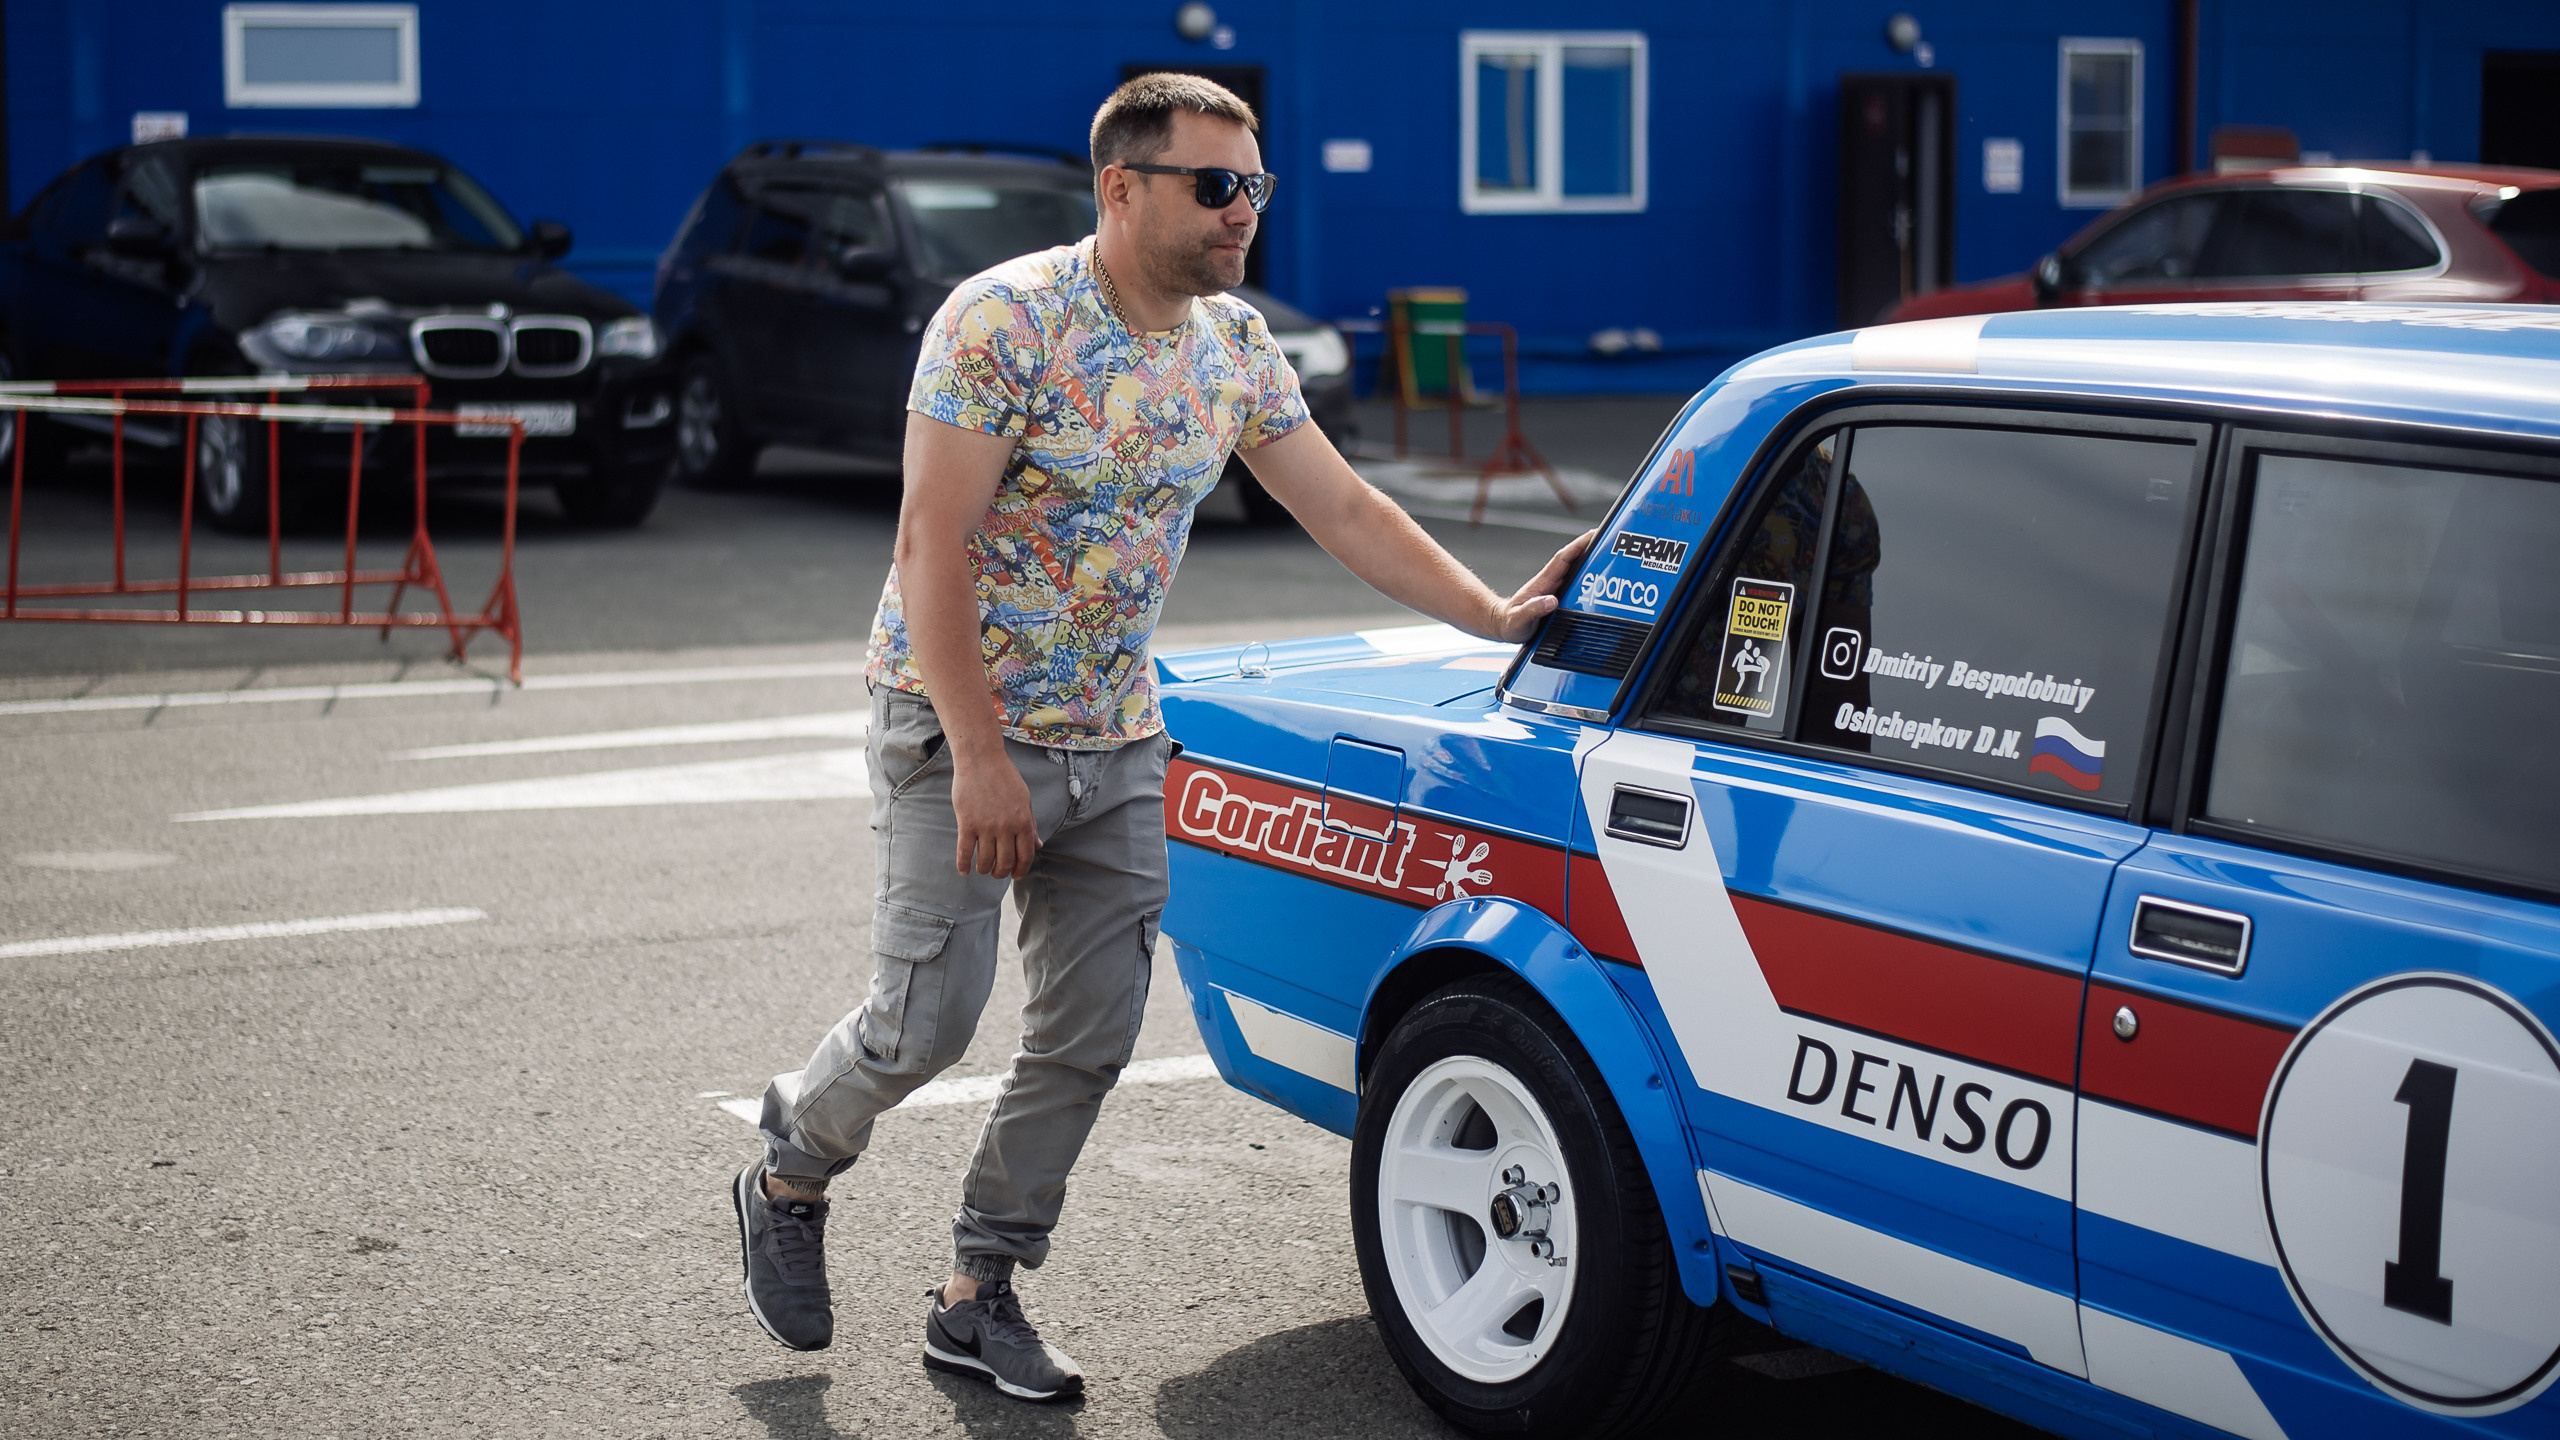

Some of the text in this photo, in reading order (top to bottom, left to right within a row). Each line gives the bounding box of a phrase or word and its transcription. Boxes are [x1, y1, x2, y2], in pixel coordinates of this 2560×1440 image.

[960, 356, 996, 373] BARTO
[1121, 430, 1150, 458] BARTO
[1612, 532, 1688, 565] PERAM
[1642, 560, 1679, 572] MEDIA.COM
[1581, 573, 1659, 607] sparco
[1080, 600, 1114, 624] BARTO
[1737, 614, 1779, 631] TOUCH!
[1739, 600, 1782, 617] DO NOT
[1862, 647, 2095, 713] Dmitriy Bespodobniy
[1835, 702, 2021, 759] Oshchepkov D.N.
[1179, 771, 1416, 888] Cordiant
[1786, 1034, 2052, 1170] DENSO
[2384, 1058, 2457, 1326] 1
